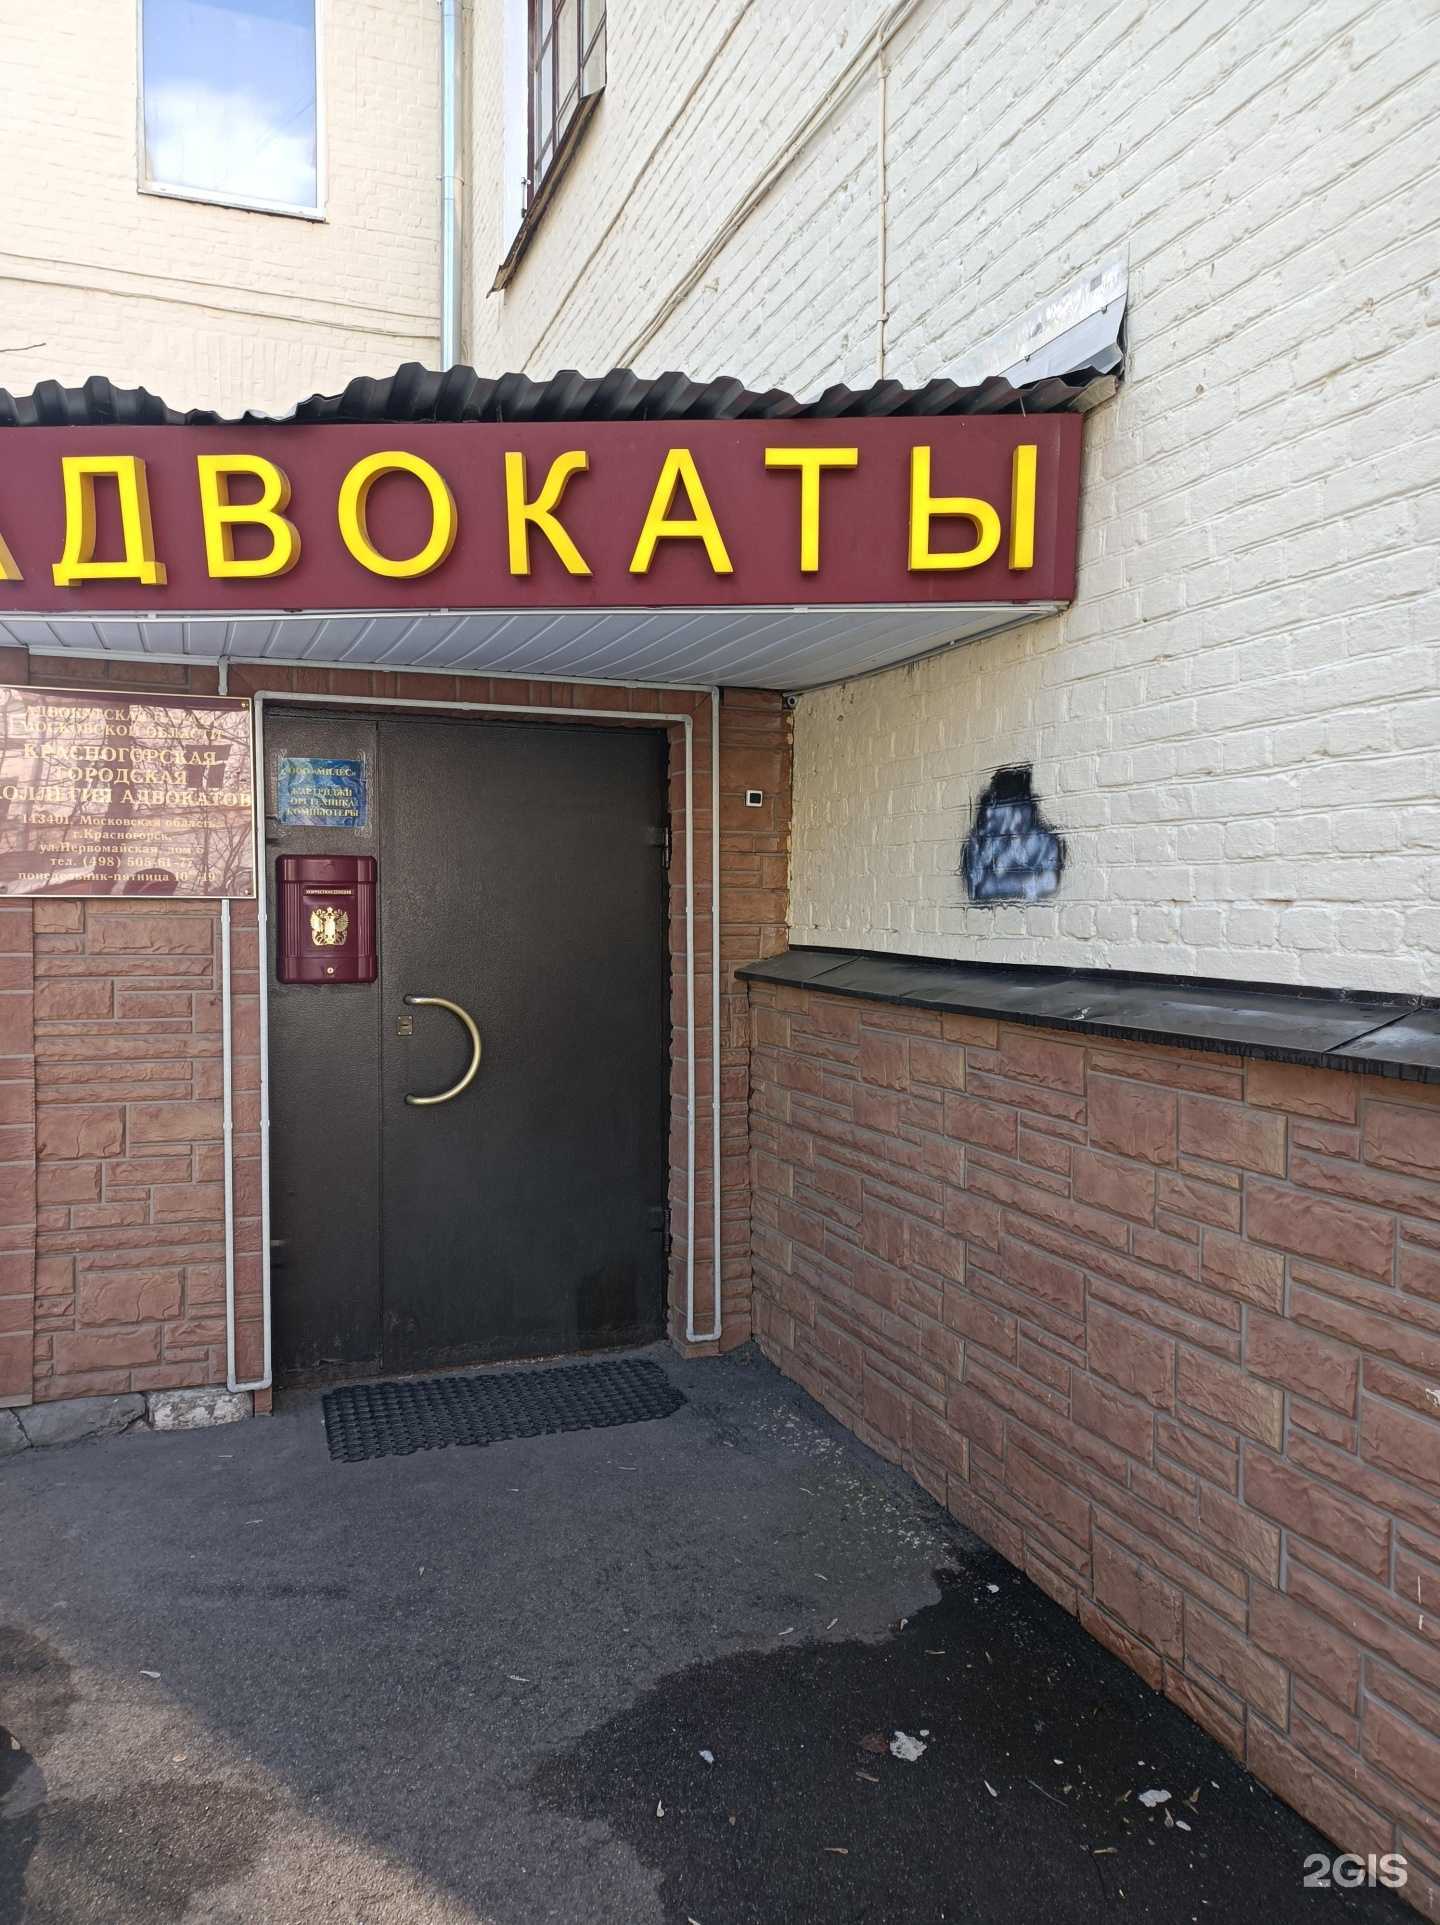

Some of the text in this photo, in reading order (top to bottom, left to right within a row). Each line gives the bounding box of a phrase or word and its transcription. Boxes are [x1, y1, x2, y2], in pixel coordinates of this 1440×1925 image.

[0, 444, 1037, 586] ДВОКАТЫ
[24, 743, 217, 765] КРАСНОГОРСКАЯ
[54, 766, 187, 785] ГОРОДСКАЯ
[0, 785, 252, 807] ОЛЛЕГИЯ АДВОКАТОВ
[80, 815, 161, 827] Московская
[83, 856, 121, 868] (498)
